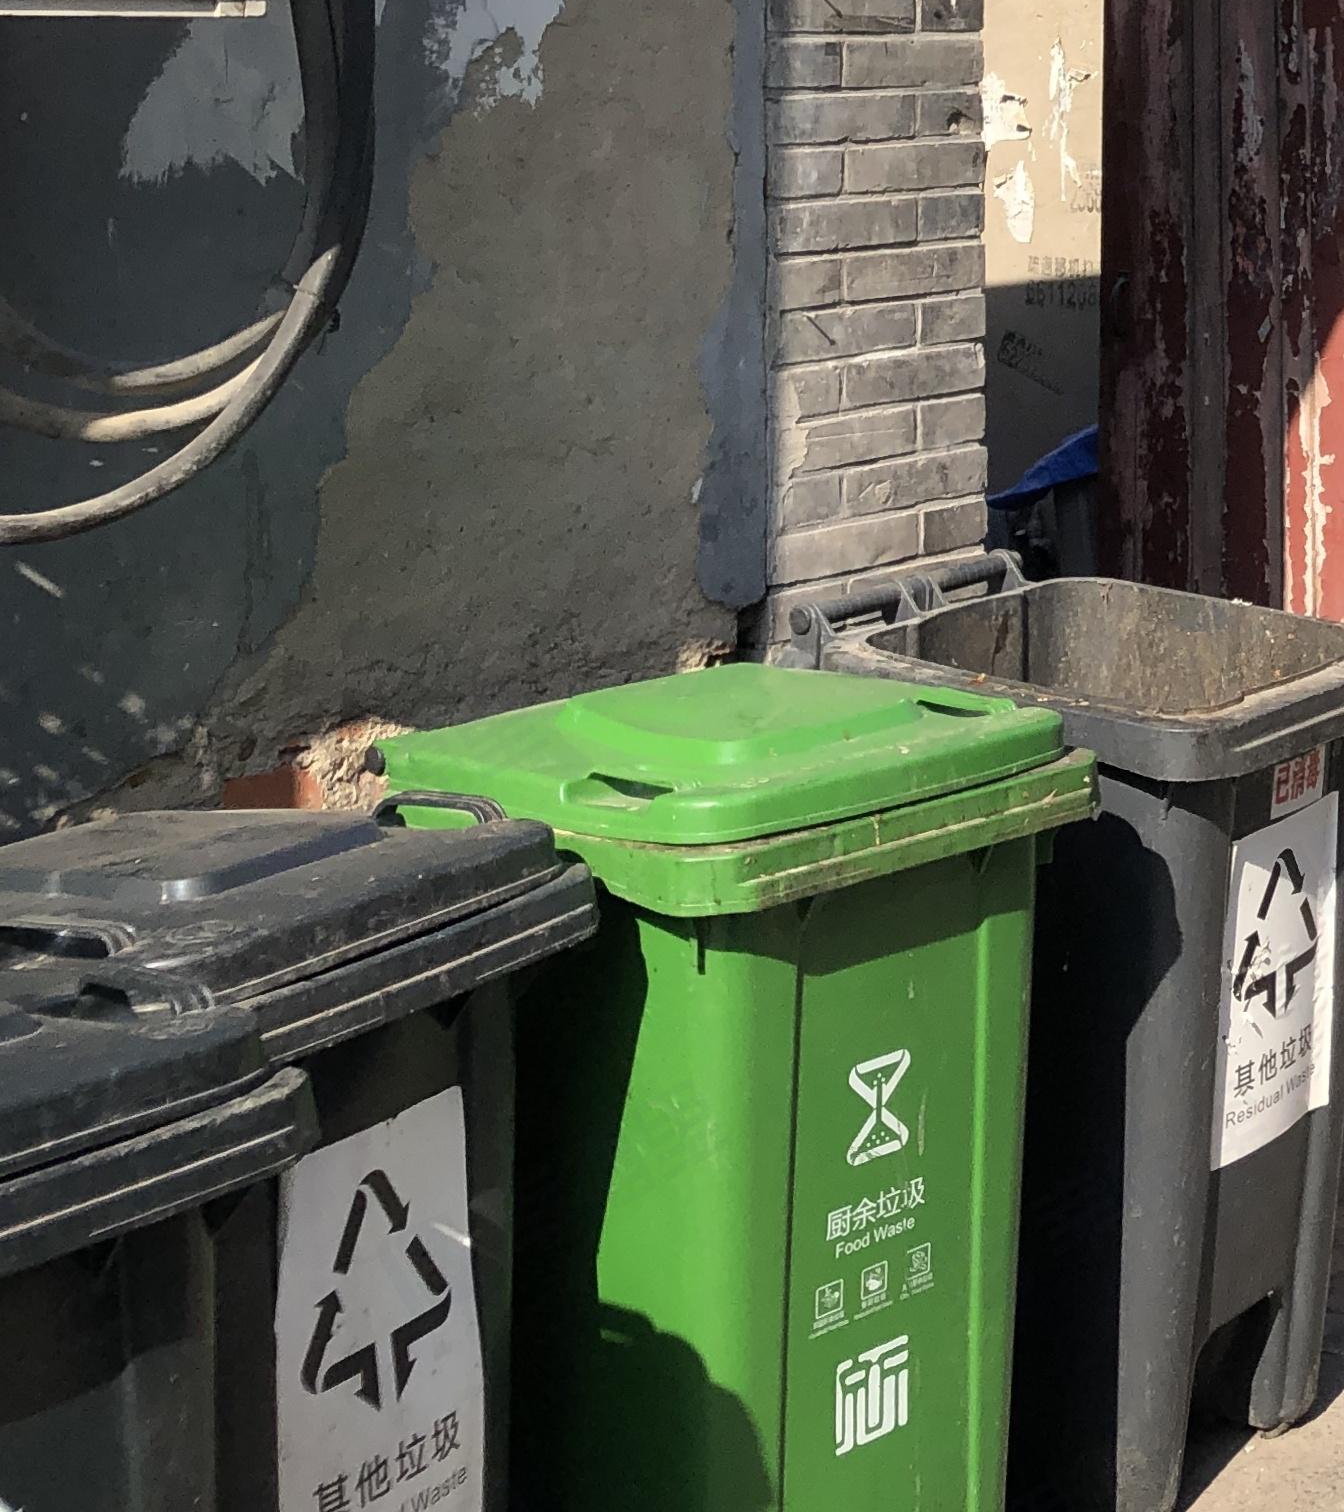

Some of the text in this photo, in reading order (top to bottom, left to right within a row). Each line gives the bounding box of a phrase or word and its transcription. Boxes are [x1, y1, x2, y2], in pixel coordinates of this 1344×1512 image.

[1233, 1023, 1312, 1098] 其他垃圾
[1225, 1085, 1284, 1129] Residual
[826, 1176, 926, 1241] 厨余垃圾
[835, 1216, 916, 1259] Food Waste
[312, 1409, 461, 1512] 其他垃圾
[411, 1466, 468, 1512] Waste
